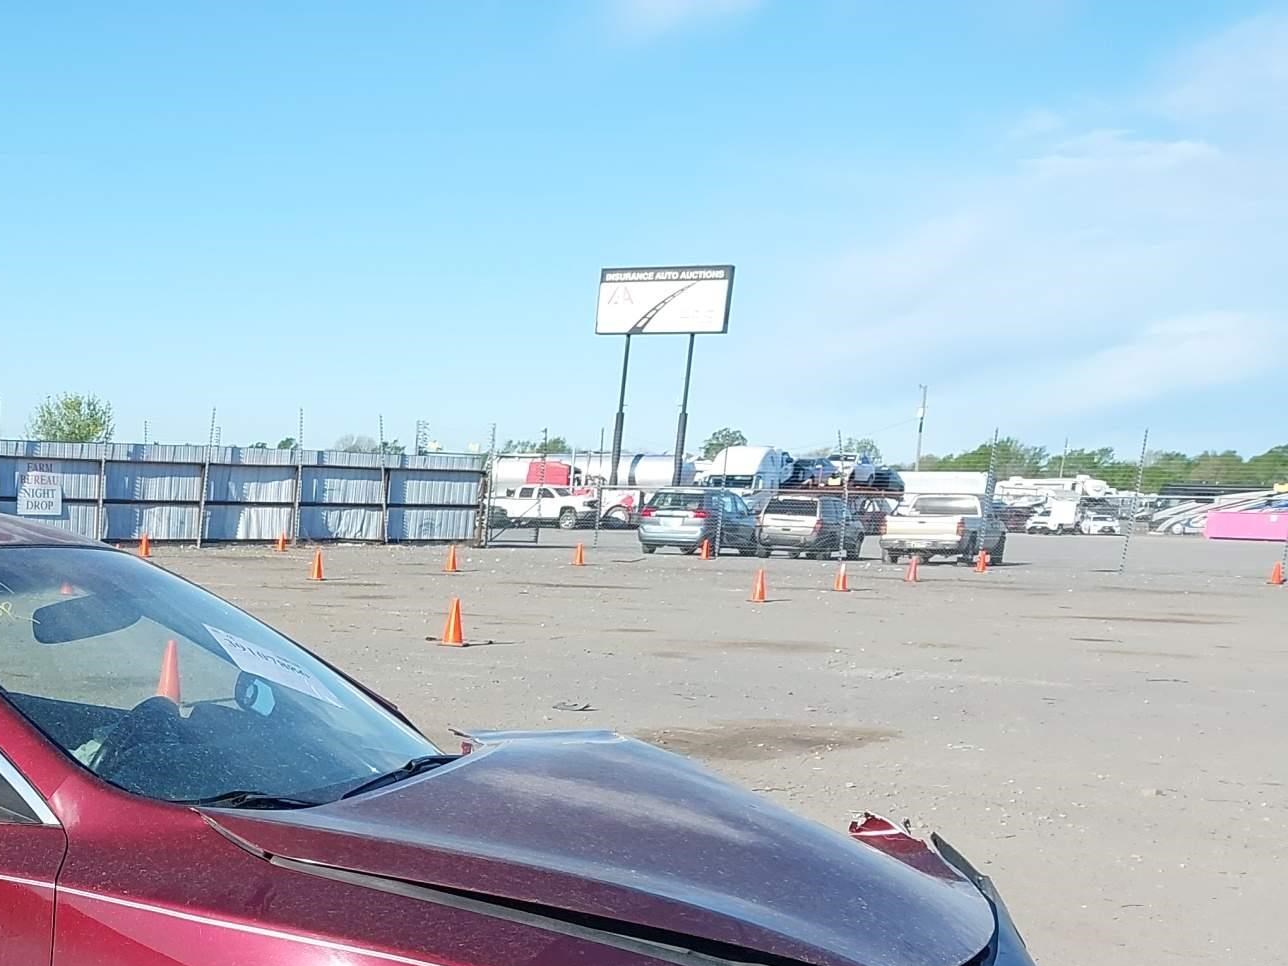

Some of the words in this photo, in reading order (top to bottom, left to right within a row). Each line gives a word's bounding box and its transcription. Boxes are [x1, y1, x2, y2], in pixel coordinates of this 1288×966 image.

[605, 271, 654, 282] INSURANCE
[655, 270, 679, 281] AUTO
[680, 269, 725, 280] AUCTIONS
[27, 462, 53, 473] FARM
[20, 475, 58, 485] BUREAU
[23, 488, 56, 499] NIGHT
[26, 501, 53, 511] DROP
